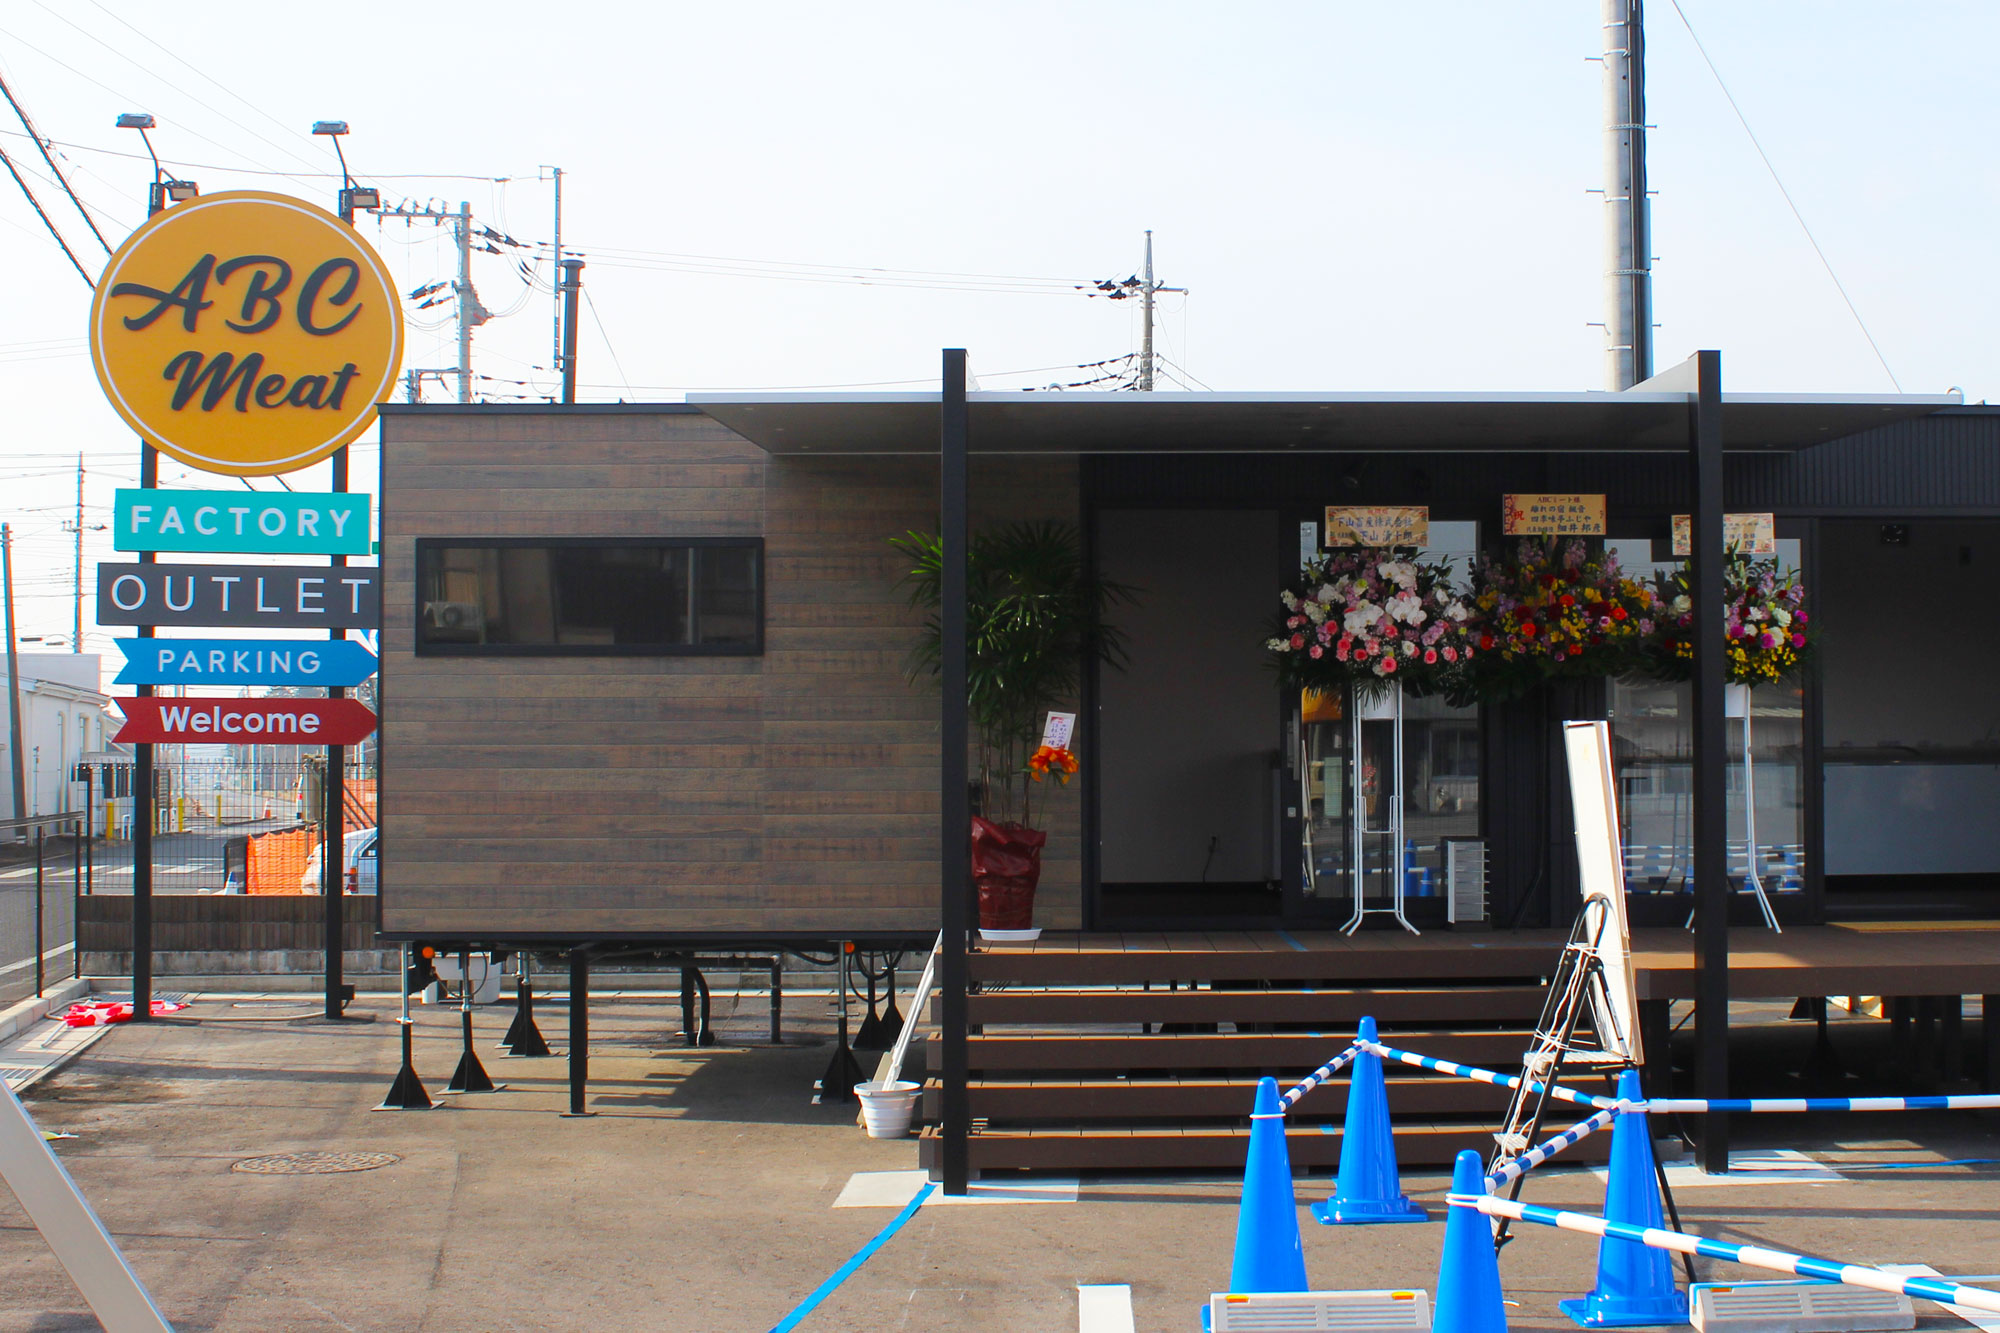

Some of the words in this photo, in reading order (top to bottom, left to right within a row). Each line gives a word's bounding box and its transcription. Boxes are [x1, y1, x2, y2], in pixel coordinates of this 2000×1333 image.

[110, 253, 363, 337] ABC
[163, 350, 360, 413] Meat
[130, 505, 352, 538] FACTORY
[111, 574, 371, 614] OUTLET
[158, 649, 322, 675] PARKING
[159, 706, 321, 734] Welcome
